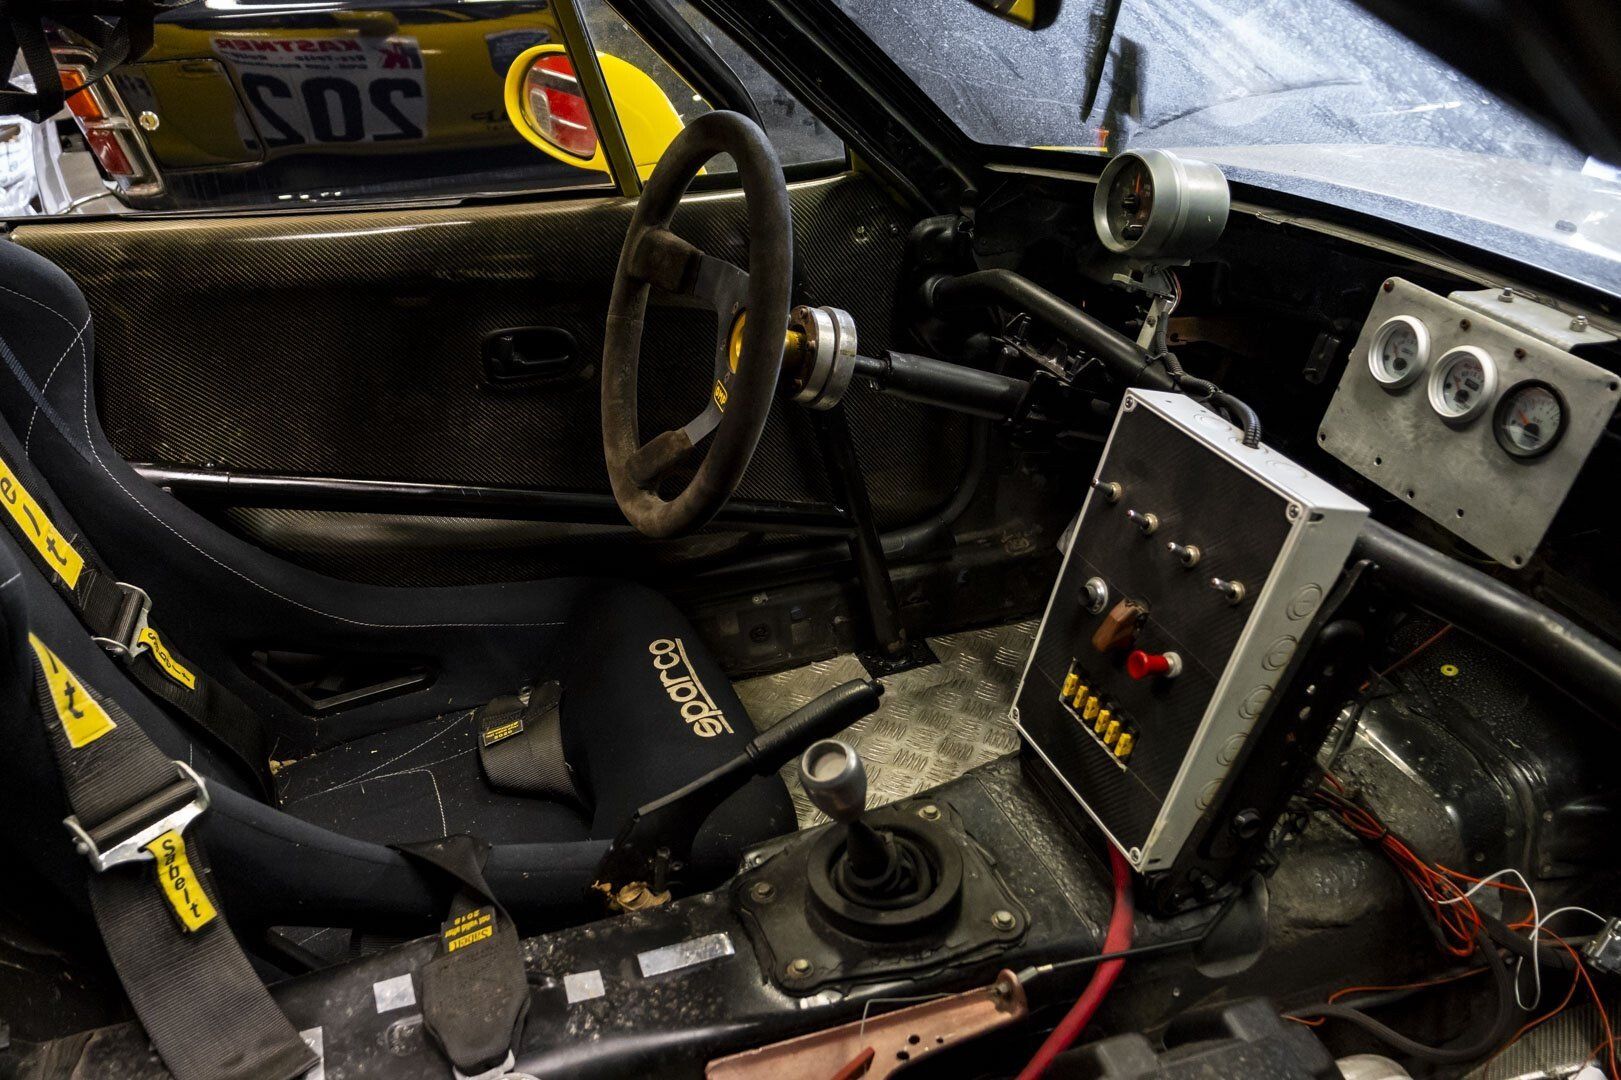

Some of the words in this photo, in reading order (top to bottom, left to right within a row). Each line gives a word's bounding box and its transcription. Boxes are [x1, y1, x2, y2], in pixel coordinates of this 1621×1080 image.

[147, 632, 190, 682] Sabelt
[648, 638, 728, 738] sparco
[162, 839, 201, 918] Sabelt
